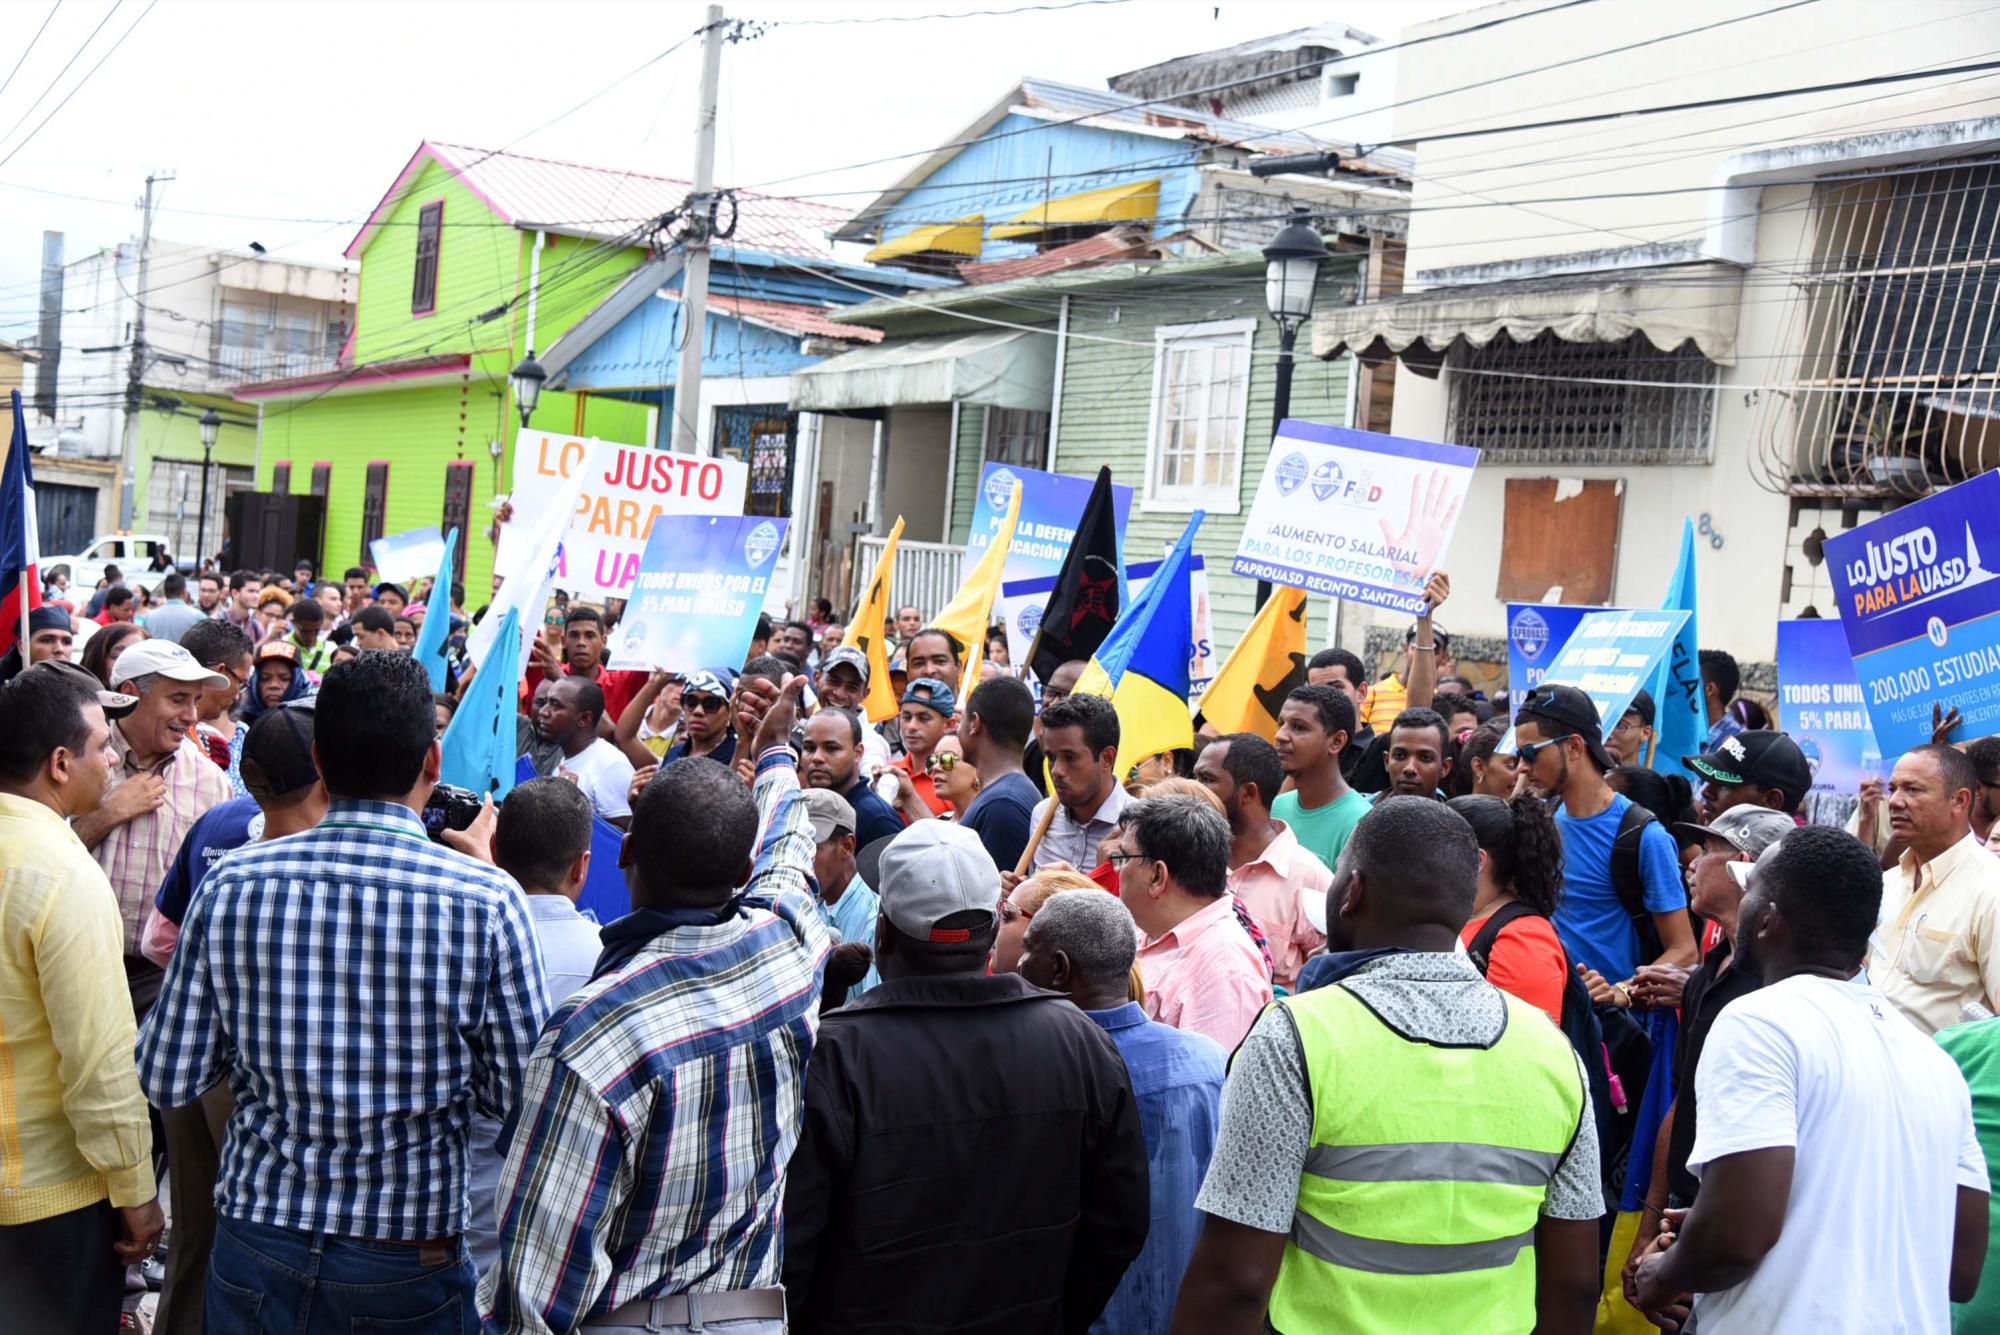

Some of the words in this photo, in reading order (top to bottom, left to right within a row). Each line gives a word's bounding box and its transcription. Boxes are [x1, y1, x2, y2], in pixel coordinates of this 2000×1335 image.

[604, 449, 723, 501] JUSTO
[972, 533, 987, 548] LA
[1018, 521, 1033, 537] LA
[1245, 539, 1282, 560] PARA
[1284, 547, 1312, 565] LOS
[1316, 555, 1432, 589] PROFESORES/A
[1349, 538, 1419, 566] SALARIAL
[1866, 526, 1938, 587] JUSTO
[638, 572, 676, 589] TODOS
[676, 573, 723, 592] UNIDOS
[724, 575, 750, 593] POR
[751, 576, 767, 595] EL
[1235, 560, 1304, 586] FAPROUASD
[1306, 575, 1359, 597] RECINTO
[1361, 588, 1426, 614] SANTIAGO
[641, 595, 660, 614] 5%
[661, 596, 691, 613] PARA
[1854, 582, 1898, 617] PARA
[1782, 684, 1829, 704] TODOS
[1869, 666, 1931, 705] 200,000
[1941, 689, 1980, 711] DOCENTES
[1979, 686, 1991, 701] EN
[1799, 711, 1822, 730] 5%
[1824, 711, 1863, 730] PARA
